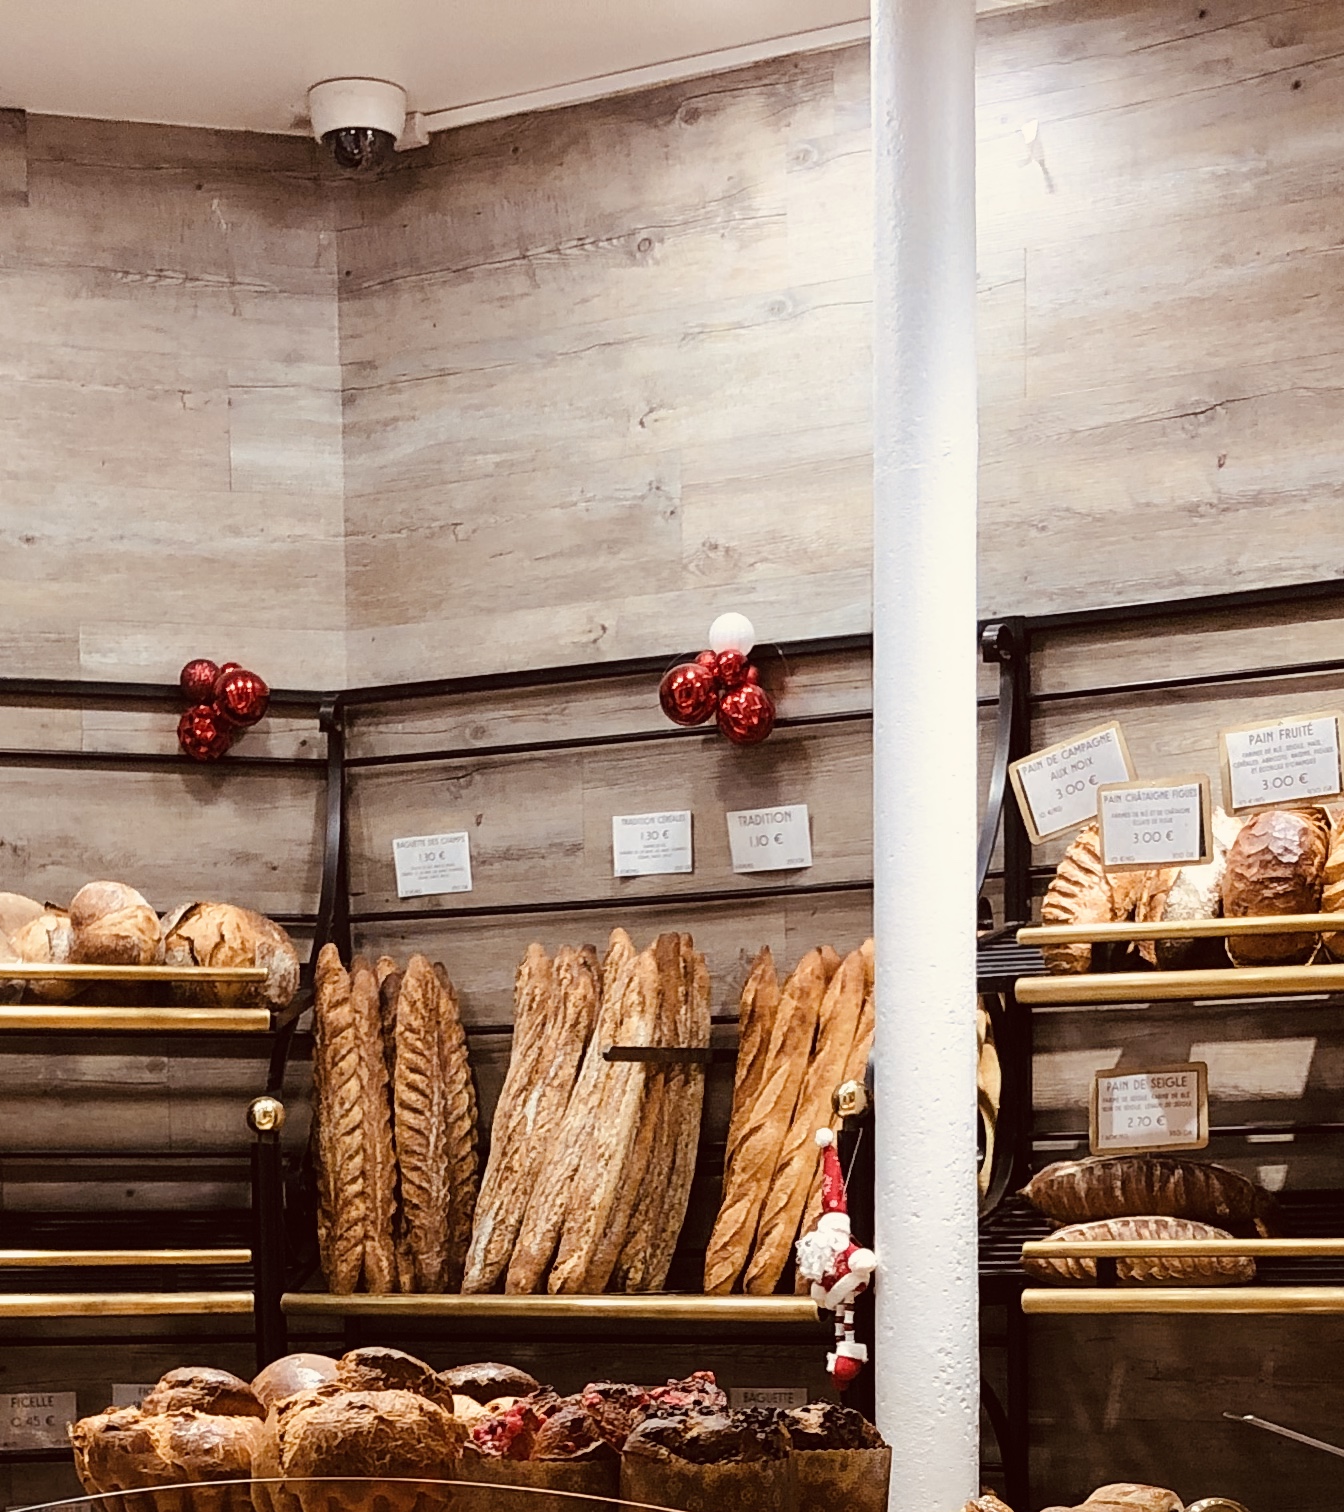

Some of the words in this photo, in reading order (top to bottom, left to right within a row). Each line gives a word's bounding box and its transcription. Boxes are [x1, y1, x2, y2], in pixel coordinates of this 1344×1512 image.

[1249, 732, 1273, 745] PAIN
[1279, 723, 1314, 740] FRUITÉ
[1023, 761, 1044, 775] PAIN
[1046, 754, 1057, 767] DE
[1061, 732, 1112, 759] CAMPAGNE
[1051, 769, 1068, 781] AUX
[1071, 757, 1094, 774] NOIX
[1089, 775, 1099, 786] €
[1299, 773, 1308, 784] €
[1104, 795, 1122, 803] PAIN
[738, 811, 792, 826] TRADITION
[774, 834, 783, 844] €
[1166, 831, 1174, 841] €
[1107, 1081, 1128, 1091] PAIN
[1134, 1080, 1146, 1090] DE
[1151, 1076, 1188, 1088] SEIGLE
[1157, 1115, 1165, 1126] €
[10, 1396, 54, 1408] FICELLE
